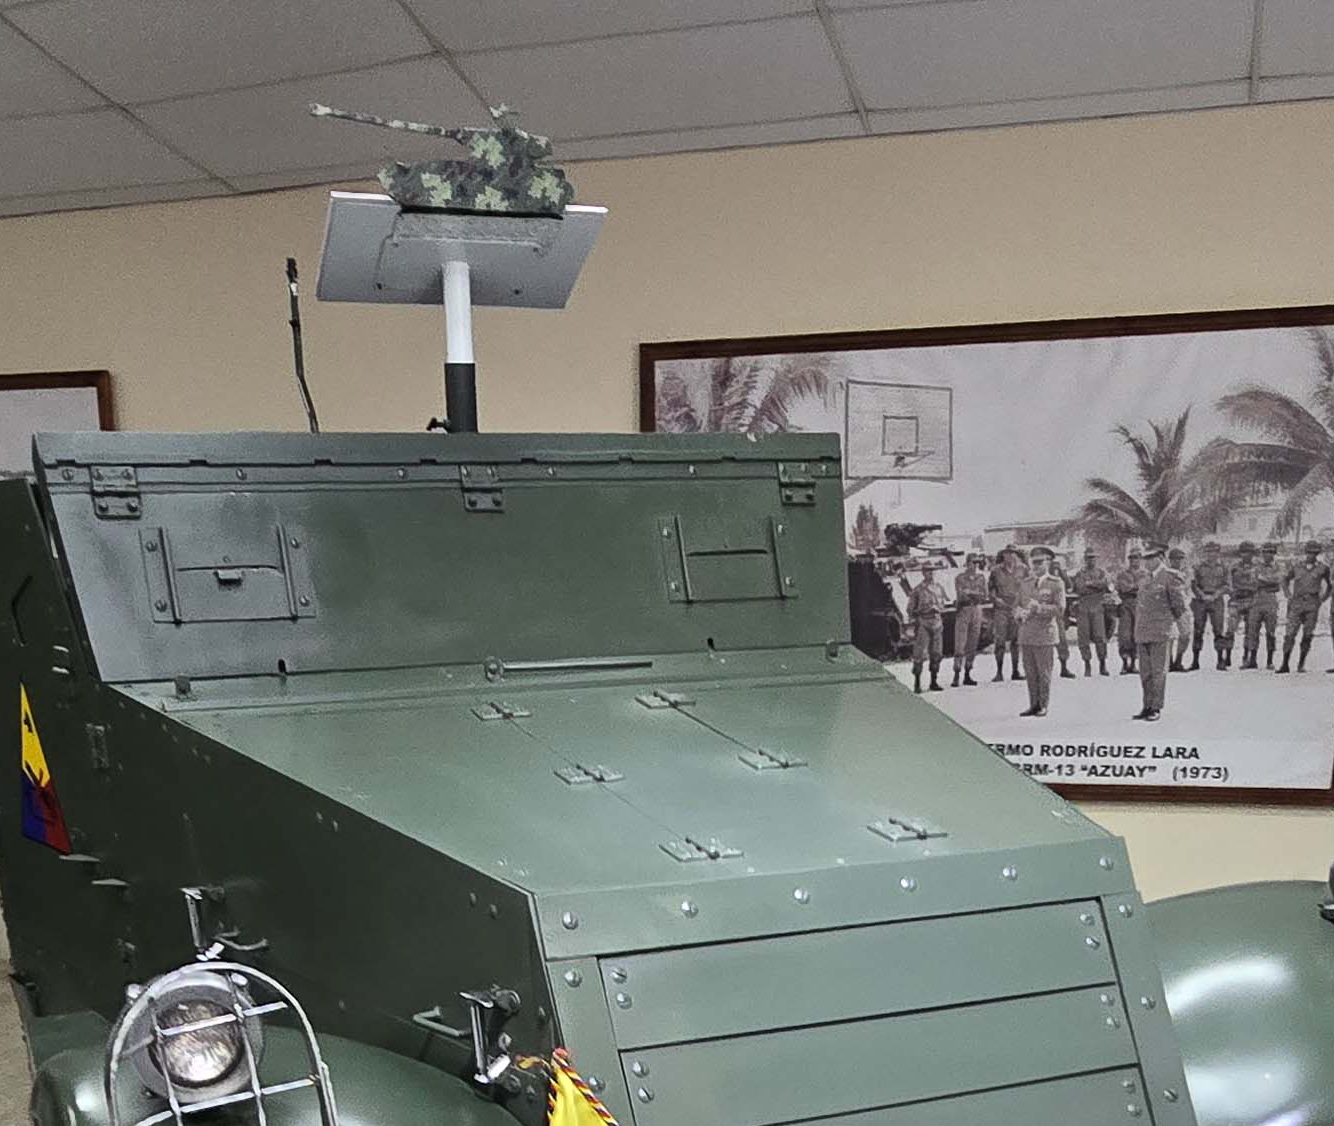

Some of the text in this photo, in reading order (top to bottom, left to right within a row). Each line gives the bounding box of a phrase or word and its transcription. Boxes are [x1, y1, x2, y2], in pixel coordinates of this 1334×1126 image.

[1040, 742, 1146, 759] RODRÍGUEZ
[1152, 746, 1200, 760] LARA
[1172, 765, 1230, 782] (1973)
